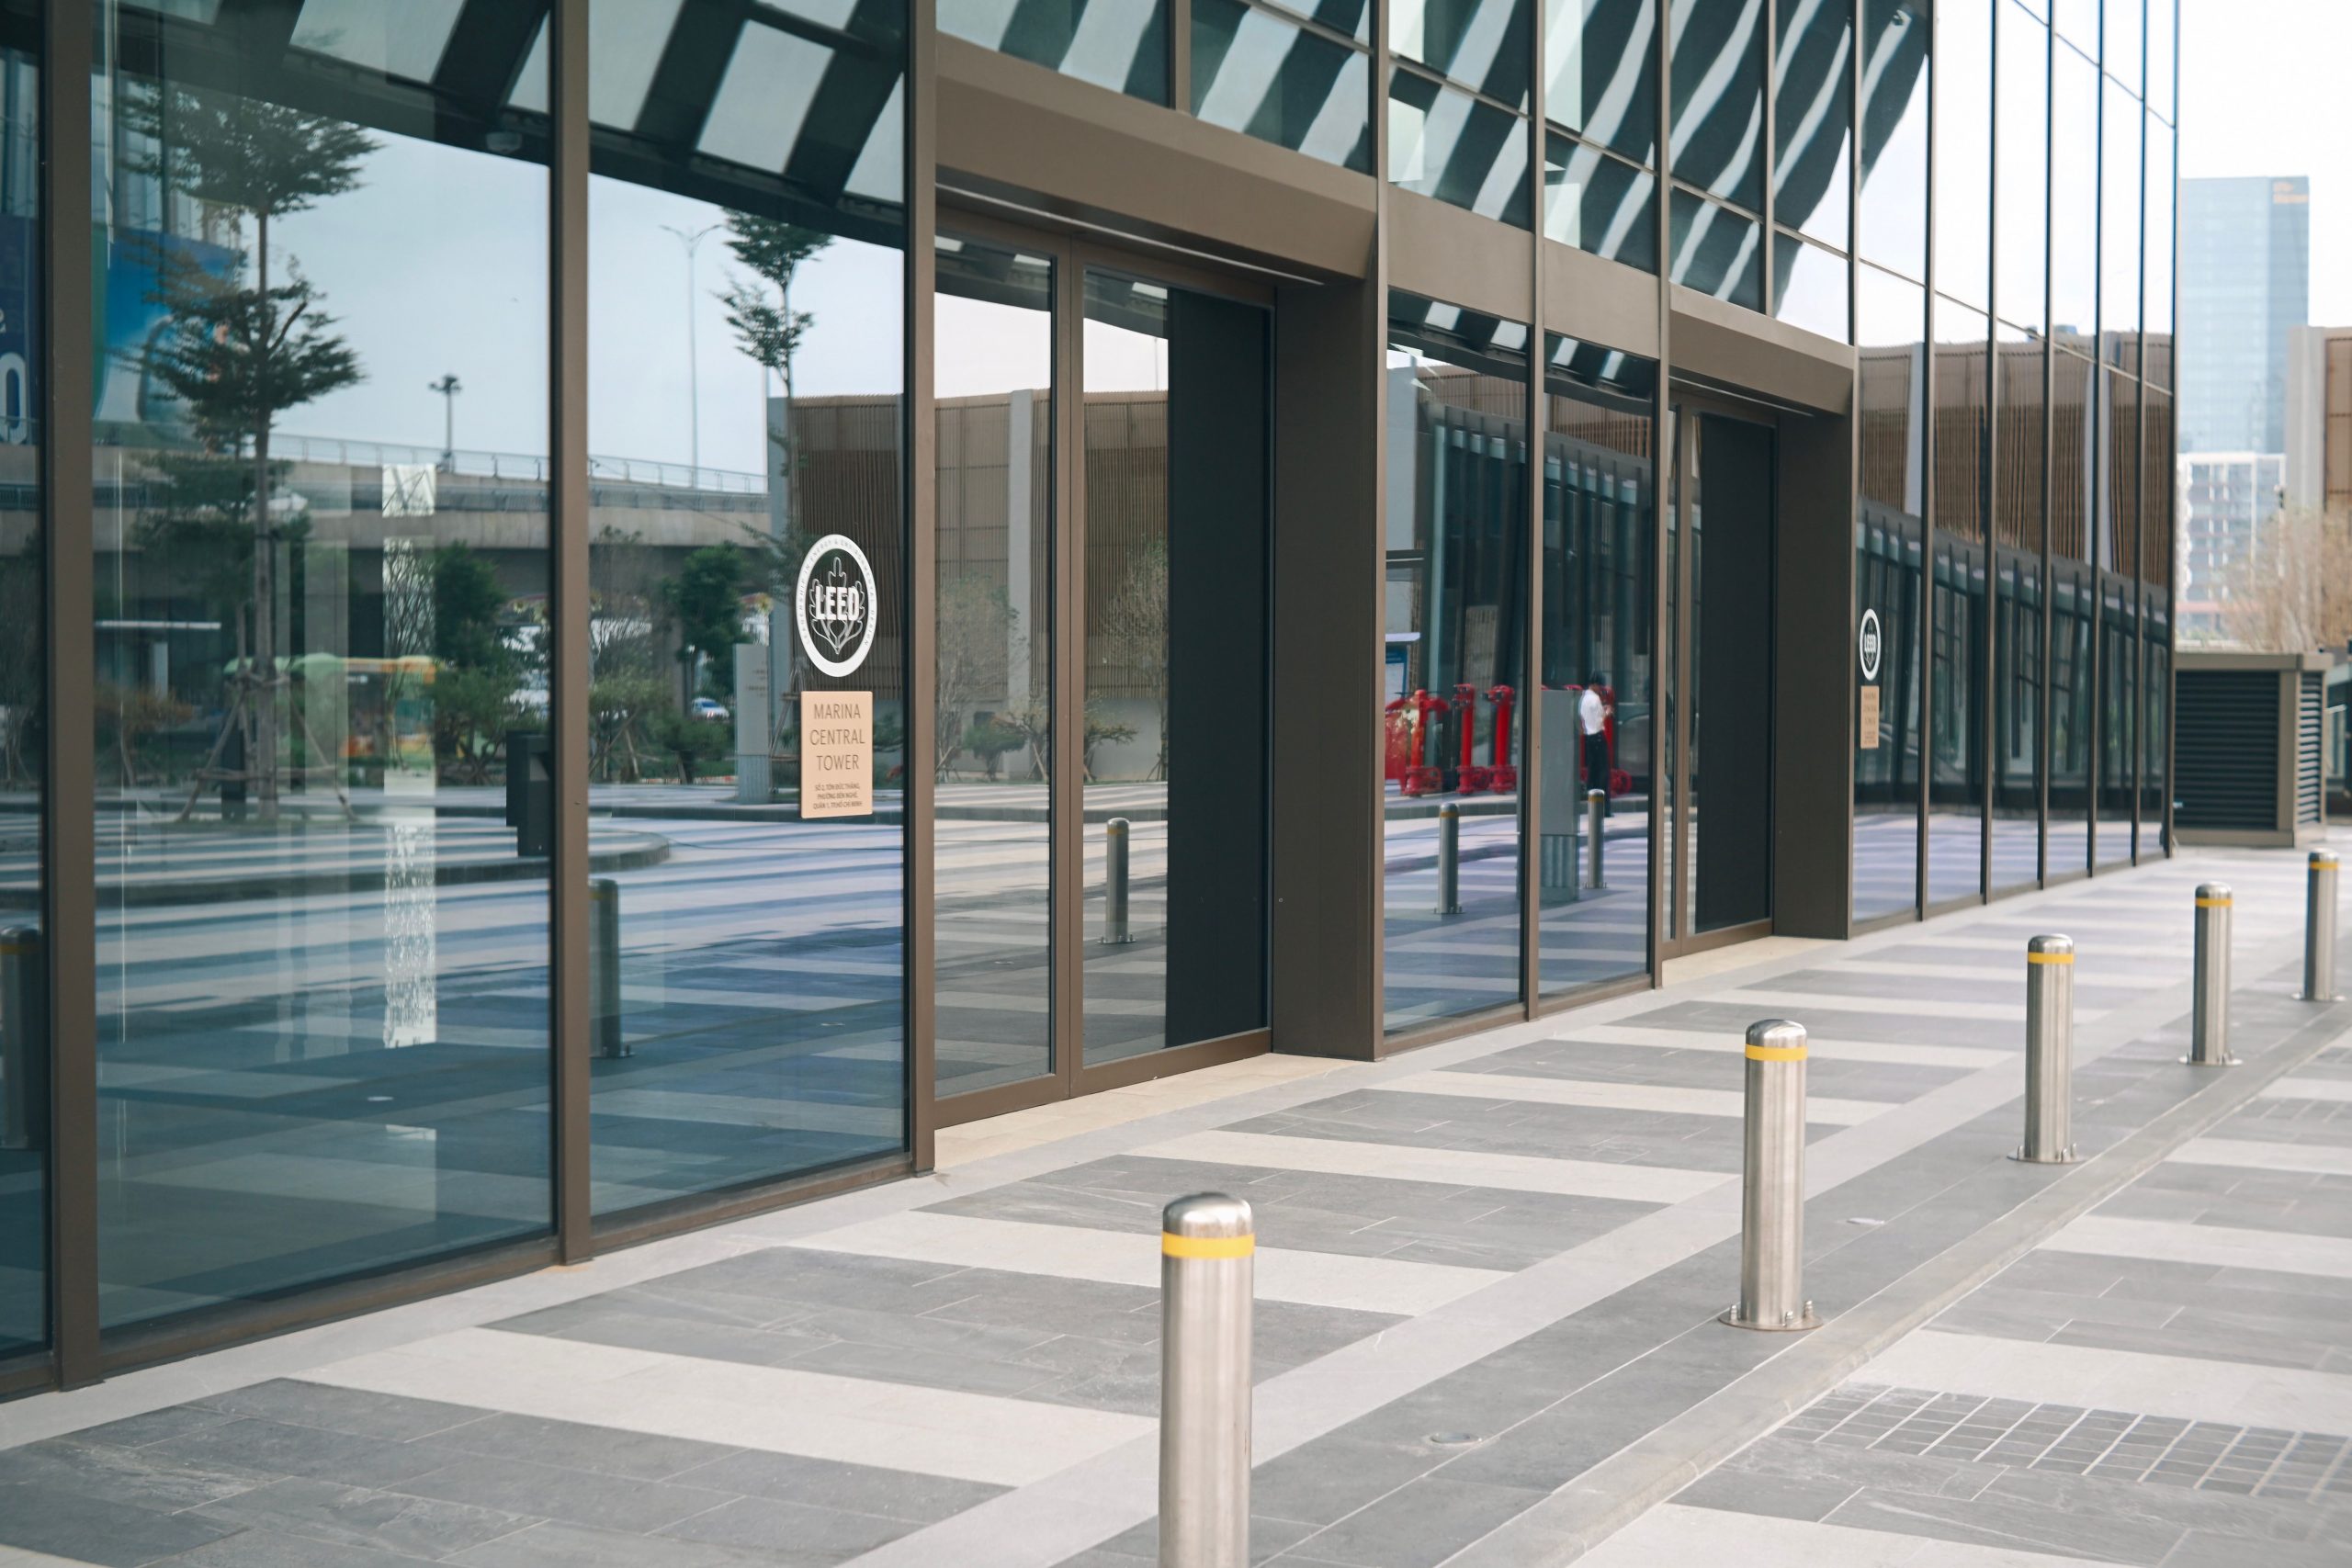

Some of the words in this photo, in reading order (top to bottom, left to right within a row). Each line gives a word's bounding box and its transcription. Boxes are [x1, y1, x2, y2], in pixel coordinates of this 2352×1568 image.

[816, 586, 860, 621] LEED
[814, 704, 861, 719] MARINA
[809, 729, 865, 745] CENTRAL
[816, 754, 859, 771] TOWER
